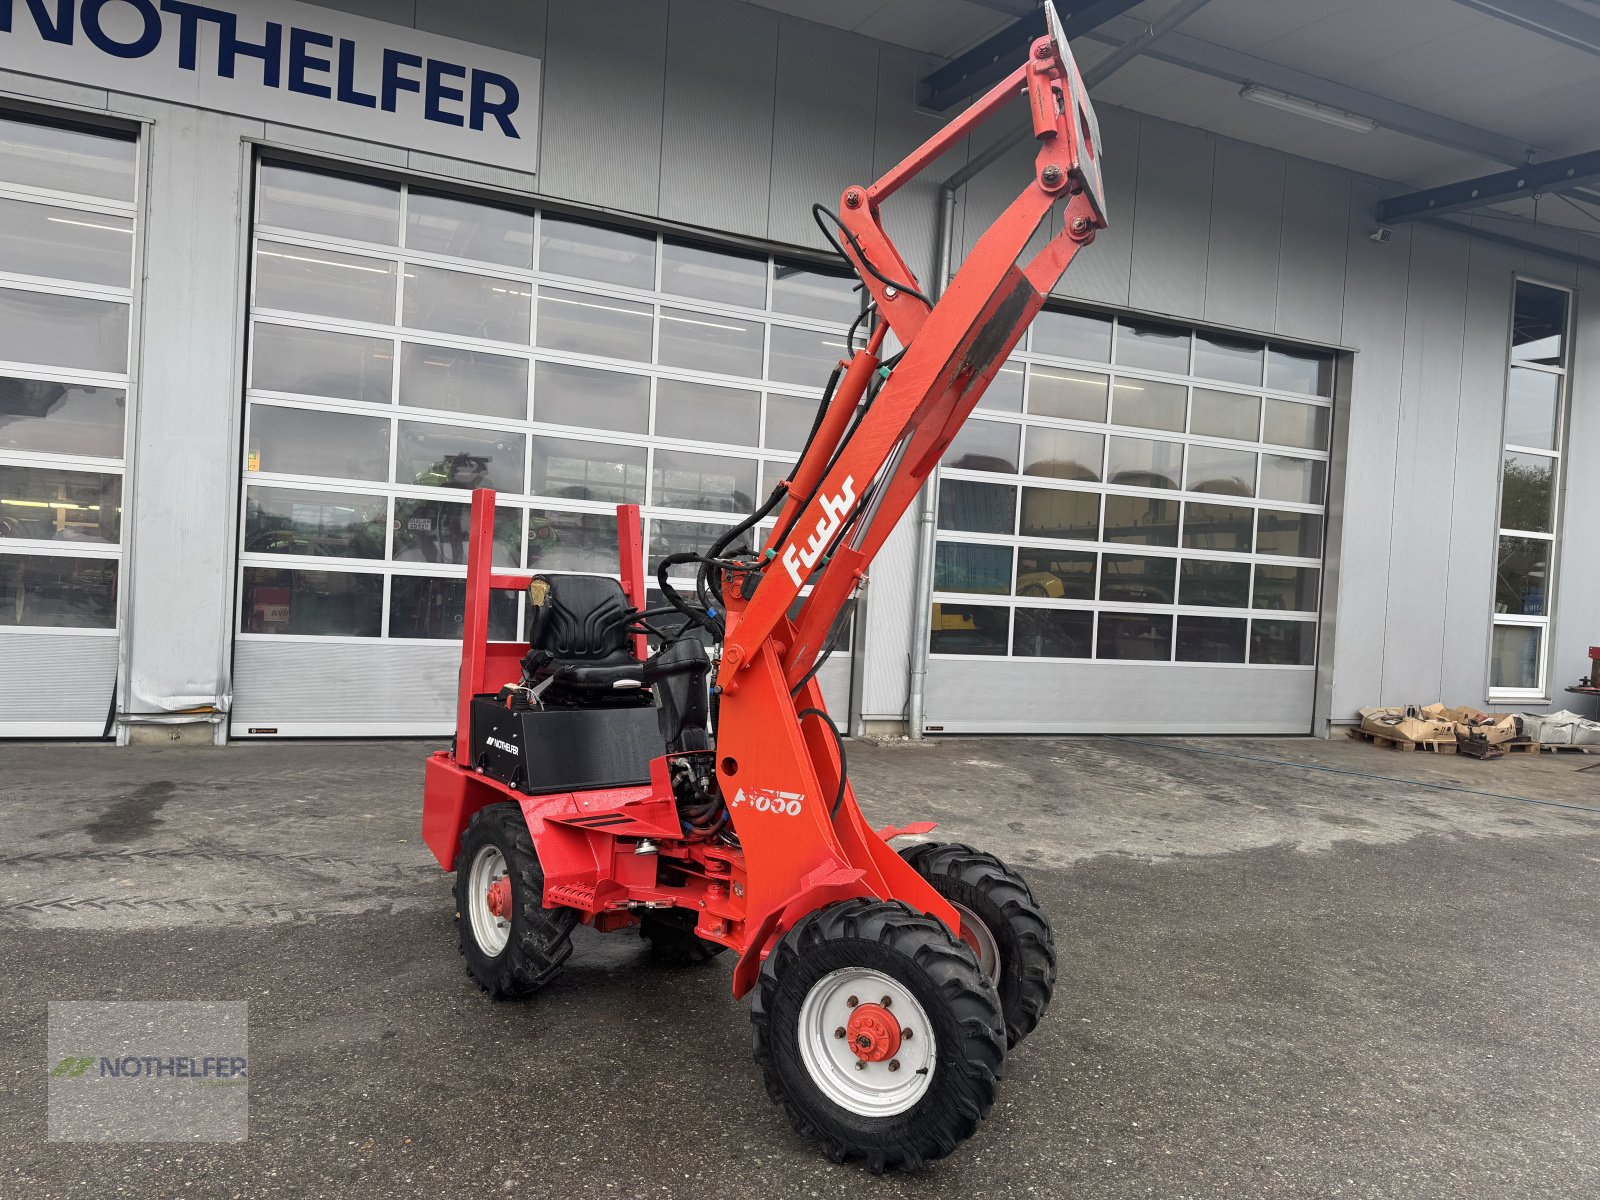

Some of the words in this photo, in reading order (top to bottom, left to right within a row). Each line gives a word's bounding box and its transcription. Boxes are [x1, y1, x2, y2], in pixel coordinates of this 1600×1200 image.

[0, 0, 521, 140] NOTHELFER
[782, 474, 856, 589] Fuchs
[493, 738, 519, 756] NOTHELFER
